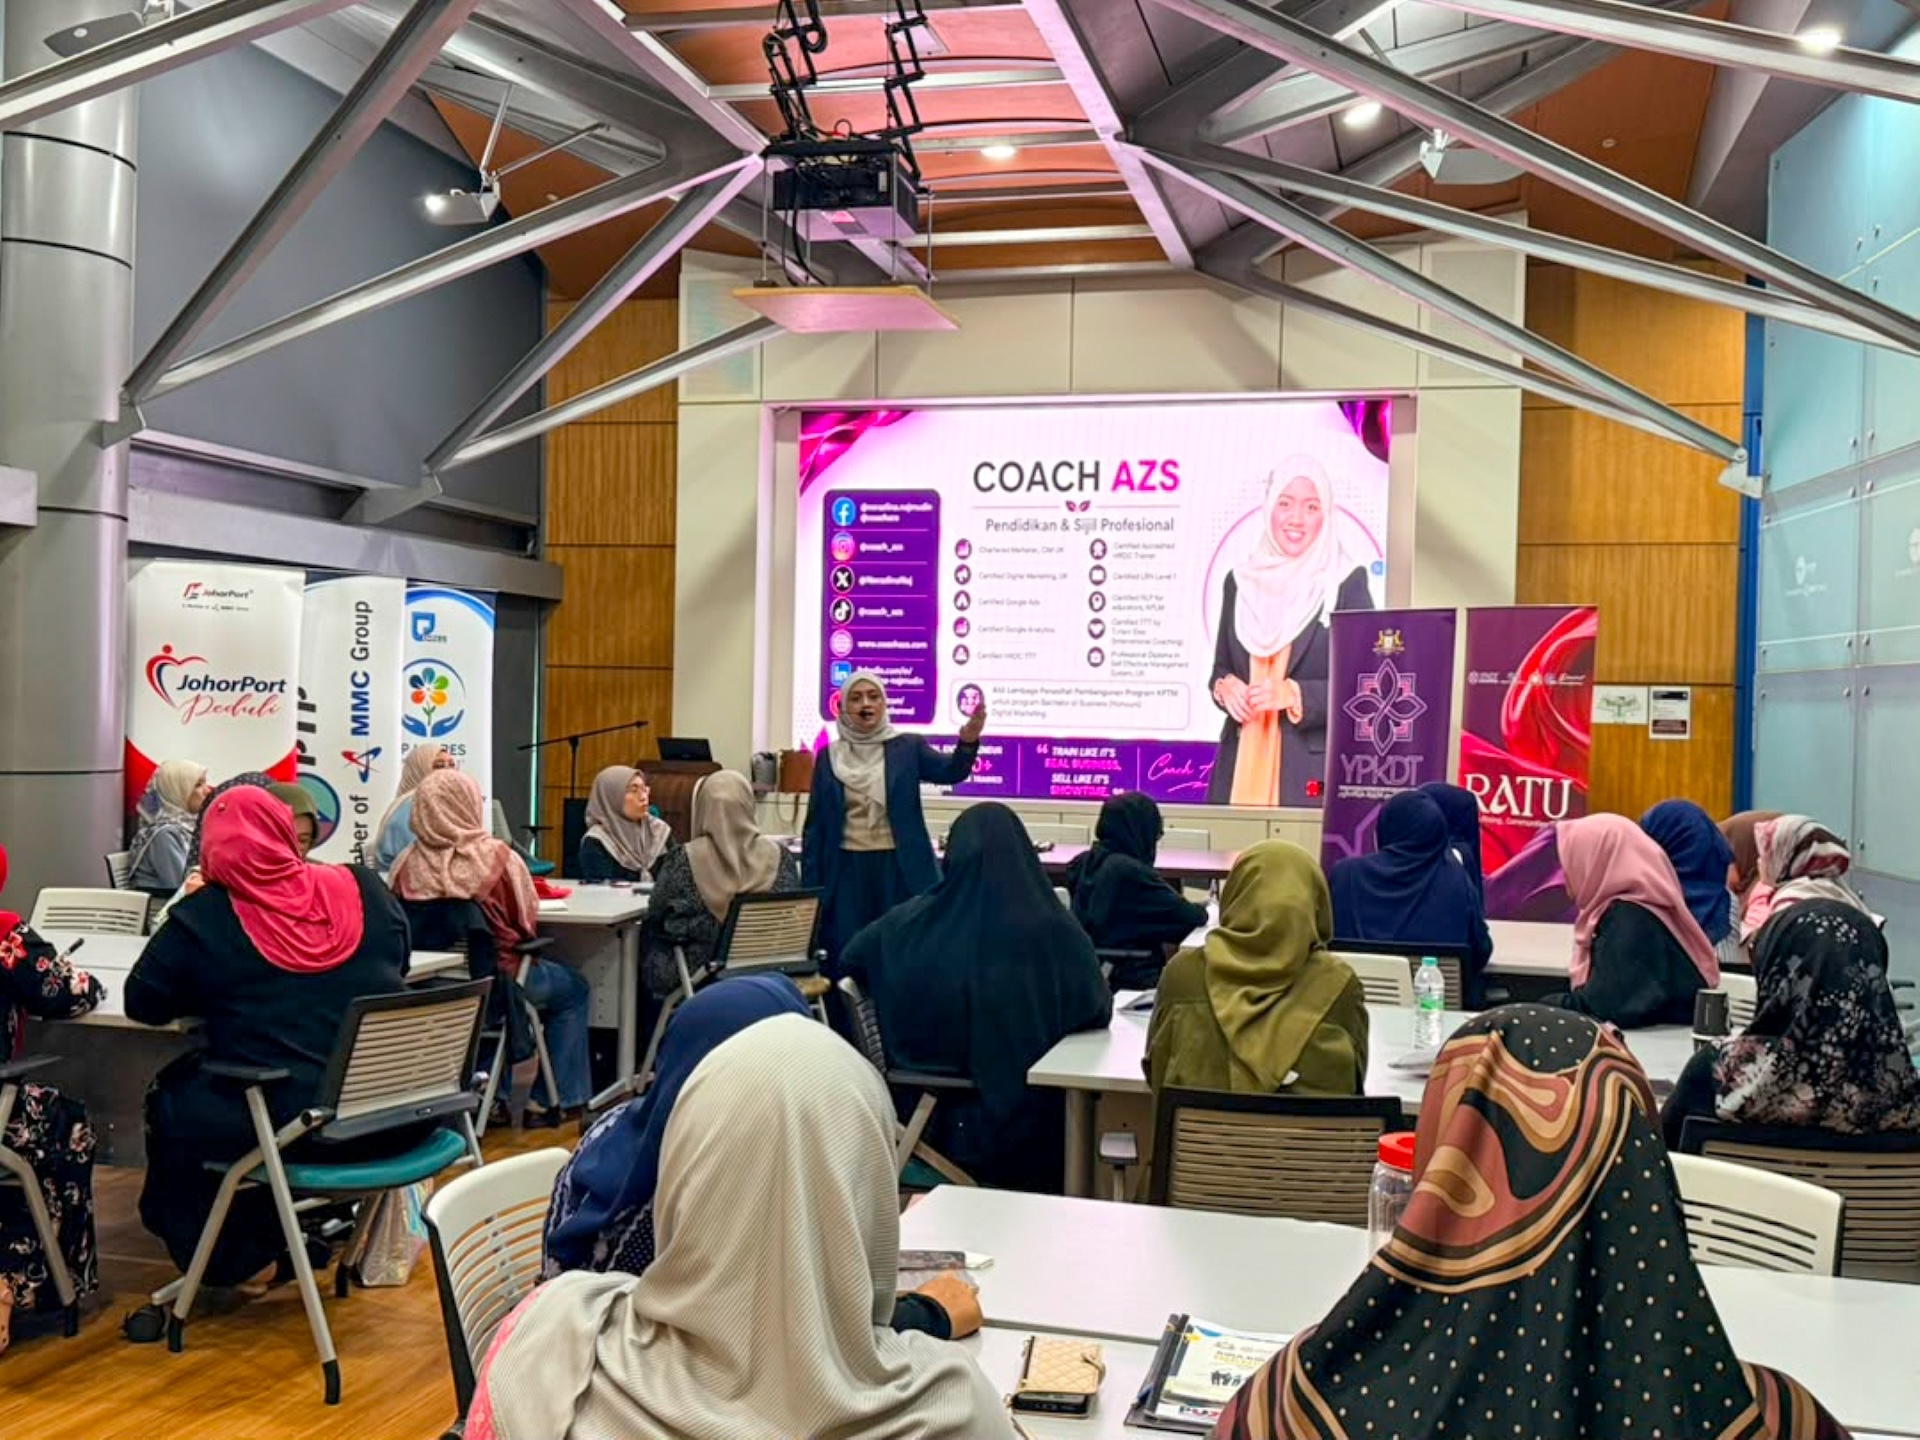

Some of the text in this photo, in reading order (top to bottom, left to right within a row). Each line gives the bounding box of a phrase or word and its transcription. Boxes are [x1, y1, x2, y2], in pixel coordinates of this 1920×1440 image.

[973, 459, 1180, 493] COACH AZS
[985, 517, 1174, 535] Pendidikan & Sijil Profesional
[350, 600, 374, 662] Group
[176, 674, 288, 694] JohorPort
[177, 692, 281, 726] Peduli
[350, 671, 370, 736] MMC
[1052, 746, 1078, 758] TRAIN
[1079, 747, 1099, 758] LIKE
[1051, 773, 1072, 784] SELL
[1073, 774, 1093, 784] LIKE
[1340, 753, 1425, 786] YPKDT
[349, 794, 370, 815] of
[1464, 773, 1573, 819] RATU
